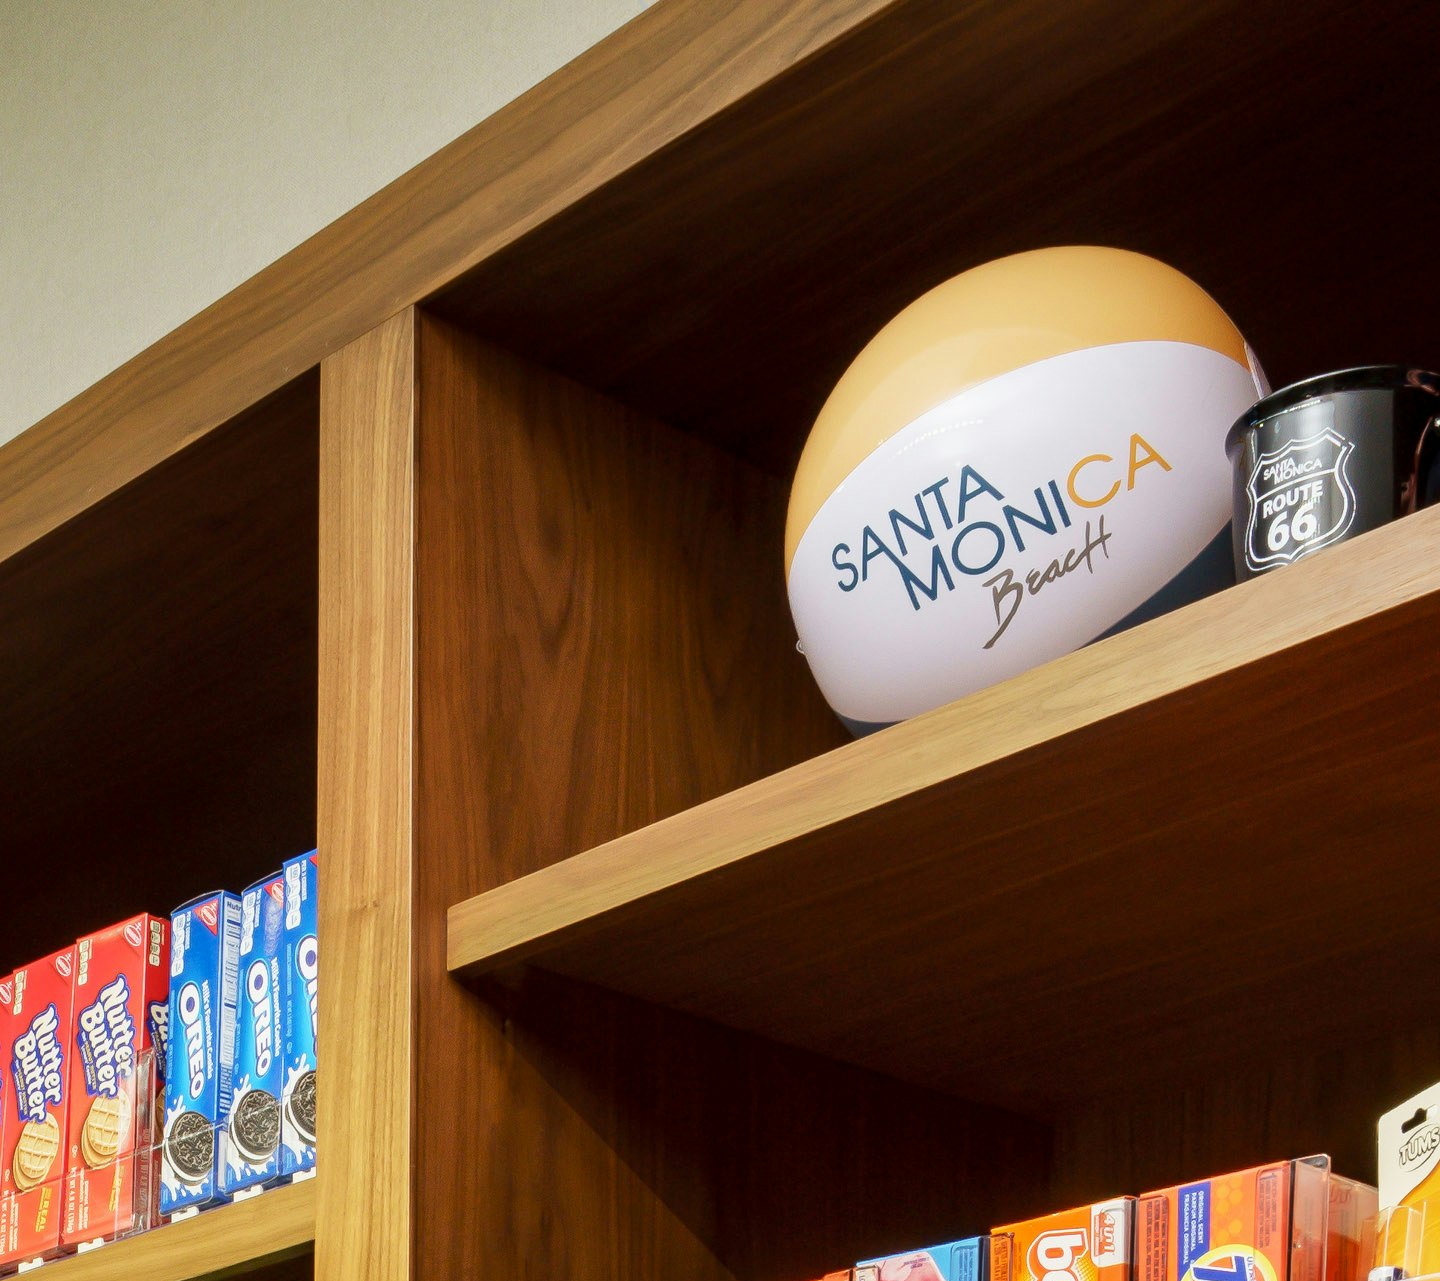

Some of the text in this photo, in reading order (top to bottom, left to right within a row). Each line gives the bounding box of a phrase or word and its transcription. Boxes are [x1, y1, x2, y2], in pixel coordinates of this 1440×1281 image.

[1263, 457, 1296, 480] SANTA
[1263, 480, 1323, 519] ROUTE
[1274, 459, 1323, 485] MONICA
[831, 464, 1005, 592] SANTA
[894, 433, 1172, 611] MONICA
[1267, 505, 1318, 551] 66
[80, 1003, 116, 1098] Butter
[100, 975, 132, 1078] Nutter
[179, 985, 205, 1099] OREO
[245, 963, 272, 1077] OREO
[1399, 1128, 1440, 1165] TUMS
